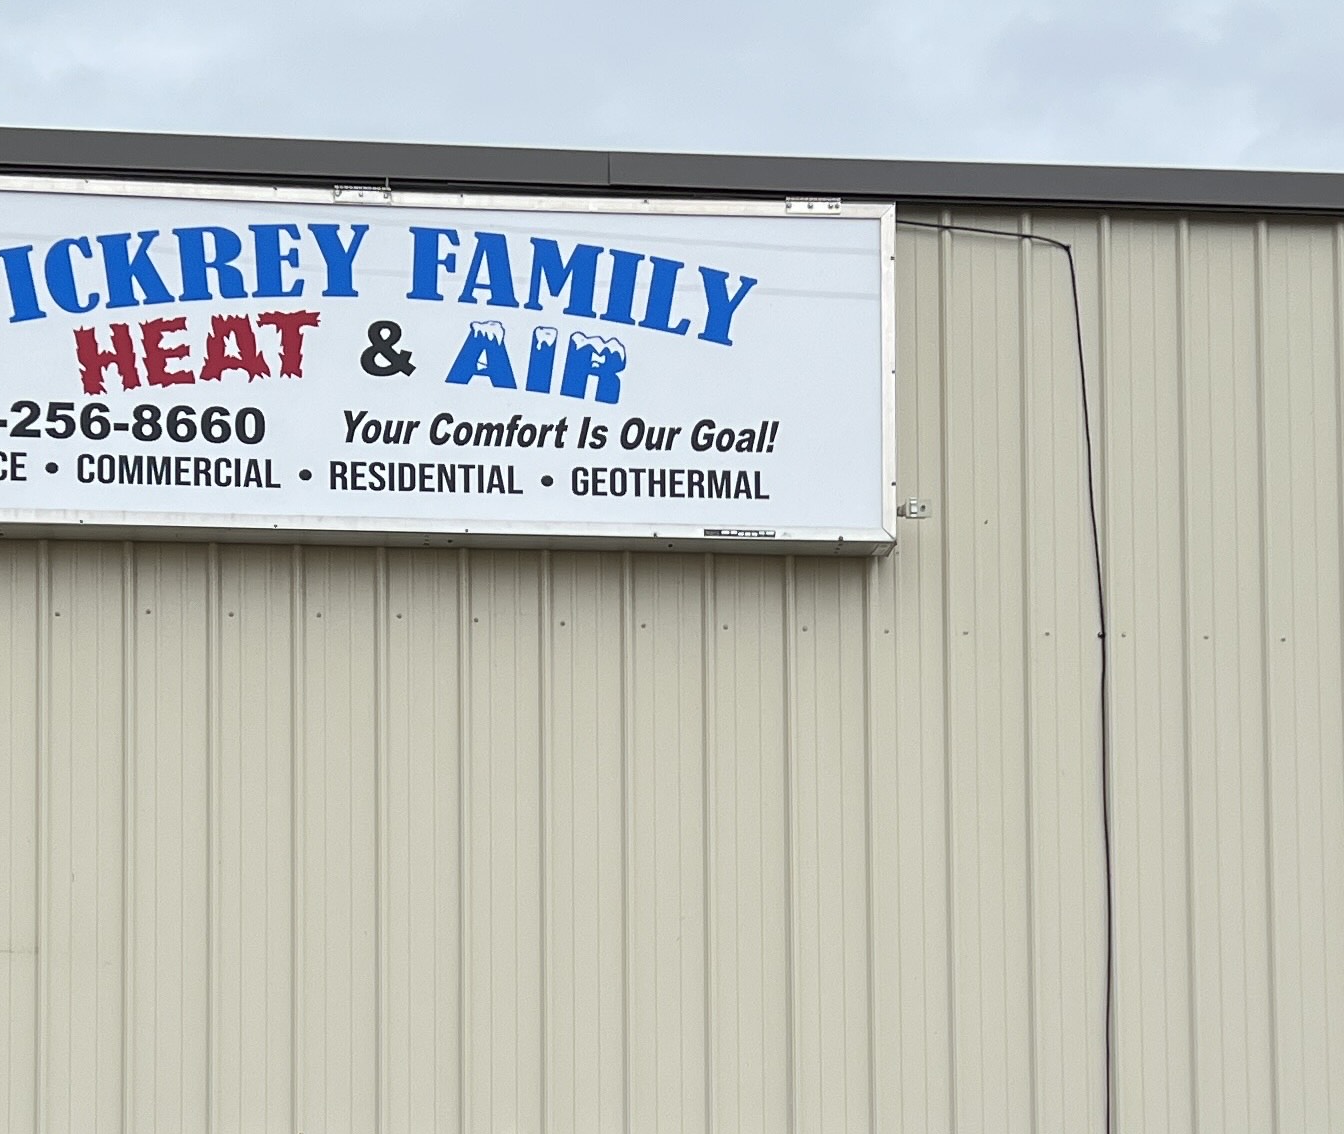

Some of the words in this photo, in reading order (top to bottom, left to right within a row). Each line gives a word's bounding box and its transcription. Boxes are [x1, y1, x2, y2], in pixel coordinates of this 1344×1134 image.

[407, 225, 758, 347] FAMILY
[73, 309, 321, 396] HEAT
[360, 320, 417, 377] &
[444, 319, 628, 405] AIR
[343, 409, 421, 446] Your
[429, 412, 569, 449] Comfort
[576, 416, 609, 450] Is
[619, 417, 683, 451] Our
[690, 418, 780, 454] Goal!
[77, 453, 282, 489] COMMERCIAL
[329, 460, 524, 495] RESIDENTIAL
[571, 466, 770, 500] GEOTHERMAL
